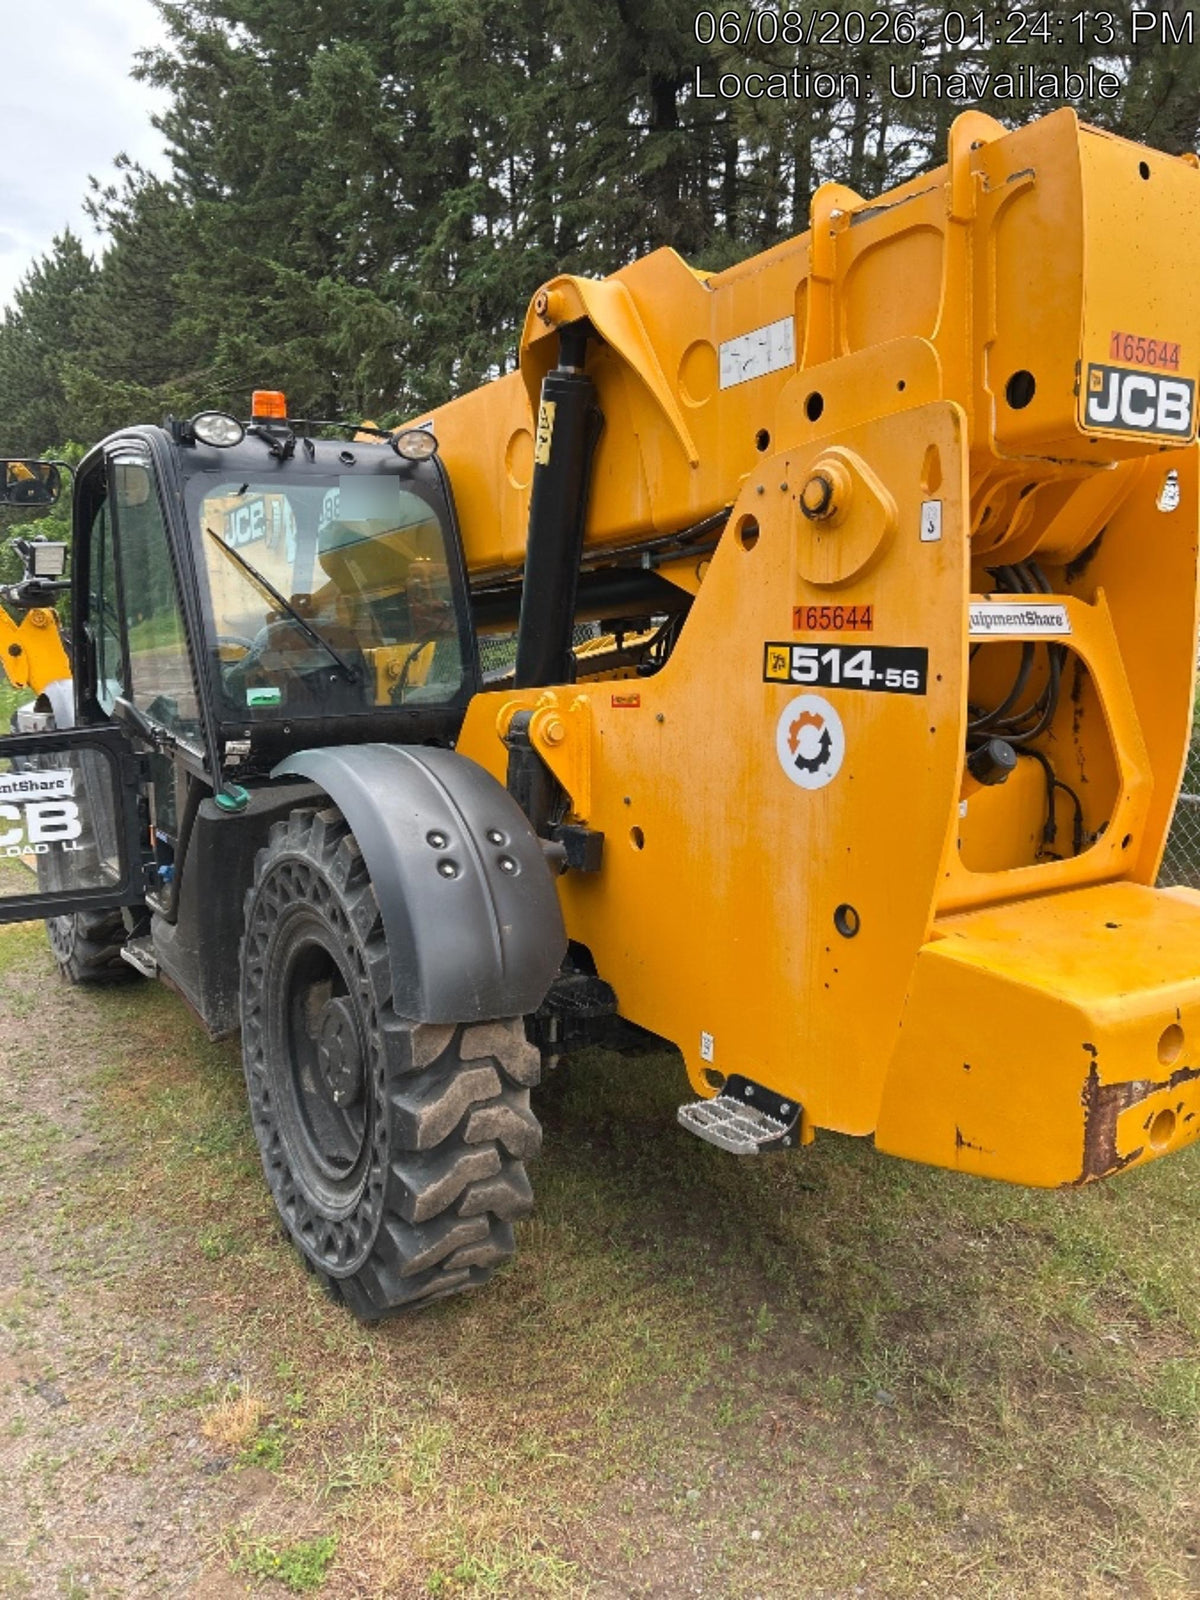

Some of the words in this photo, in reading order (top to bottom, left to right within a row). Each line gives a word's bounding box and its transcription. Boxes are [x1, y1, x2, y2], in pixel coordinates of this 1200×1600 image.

[1112, 332, 1179, 368] 165644
[1088, 372, 1191, 431] JCB
[795, 605, 873, 630] 165644
[0, 779, 65, 794] ntShare
